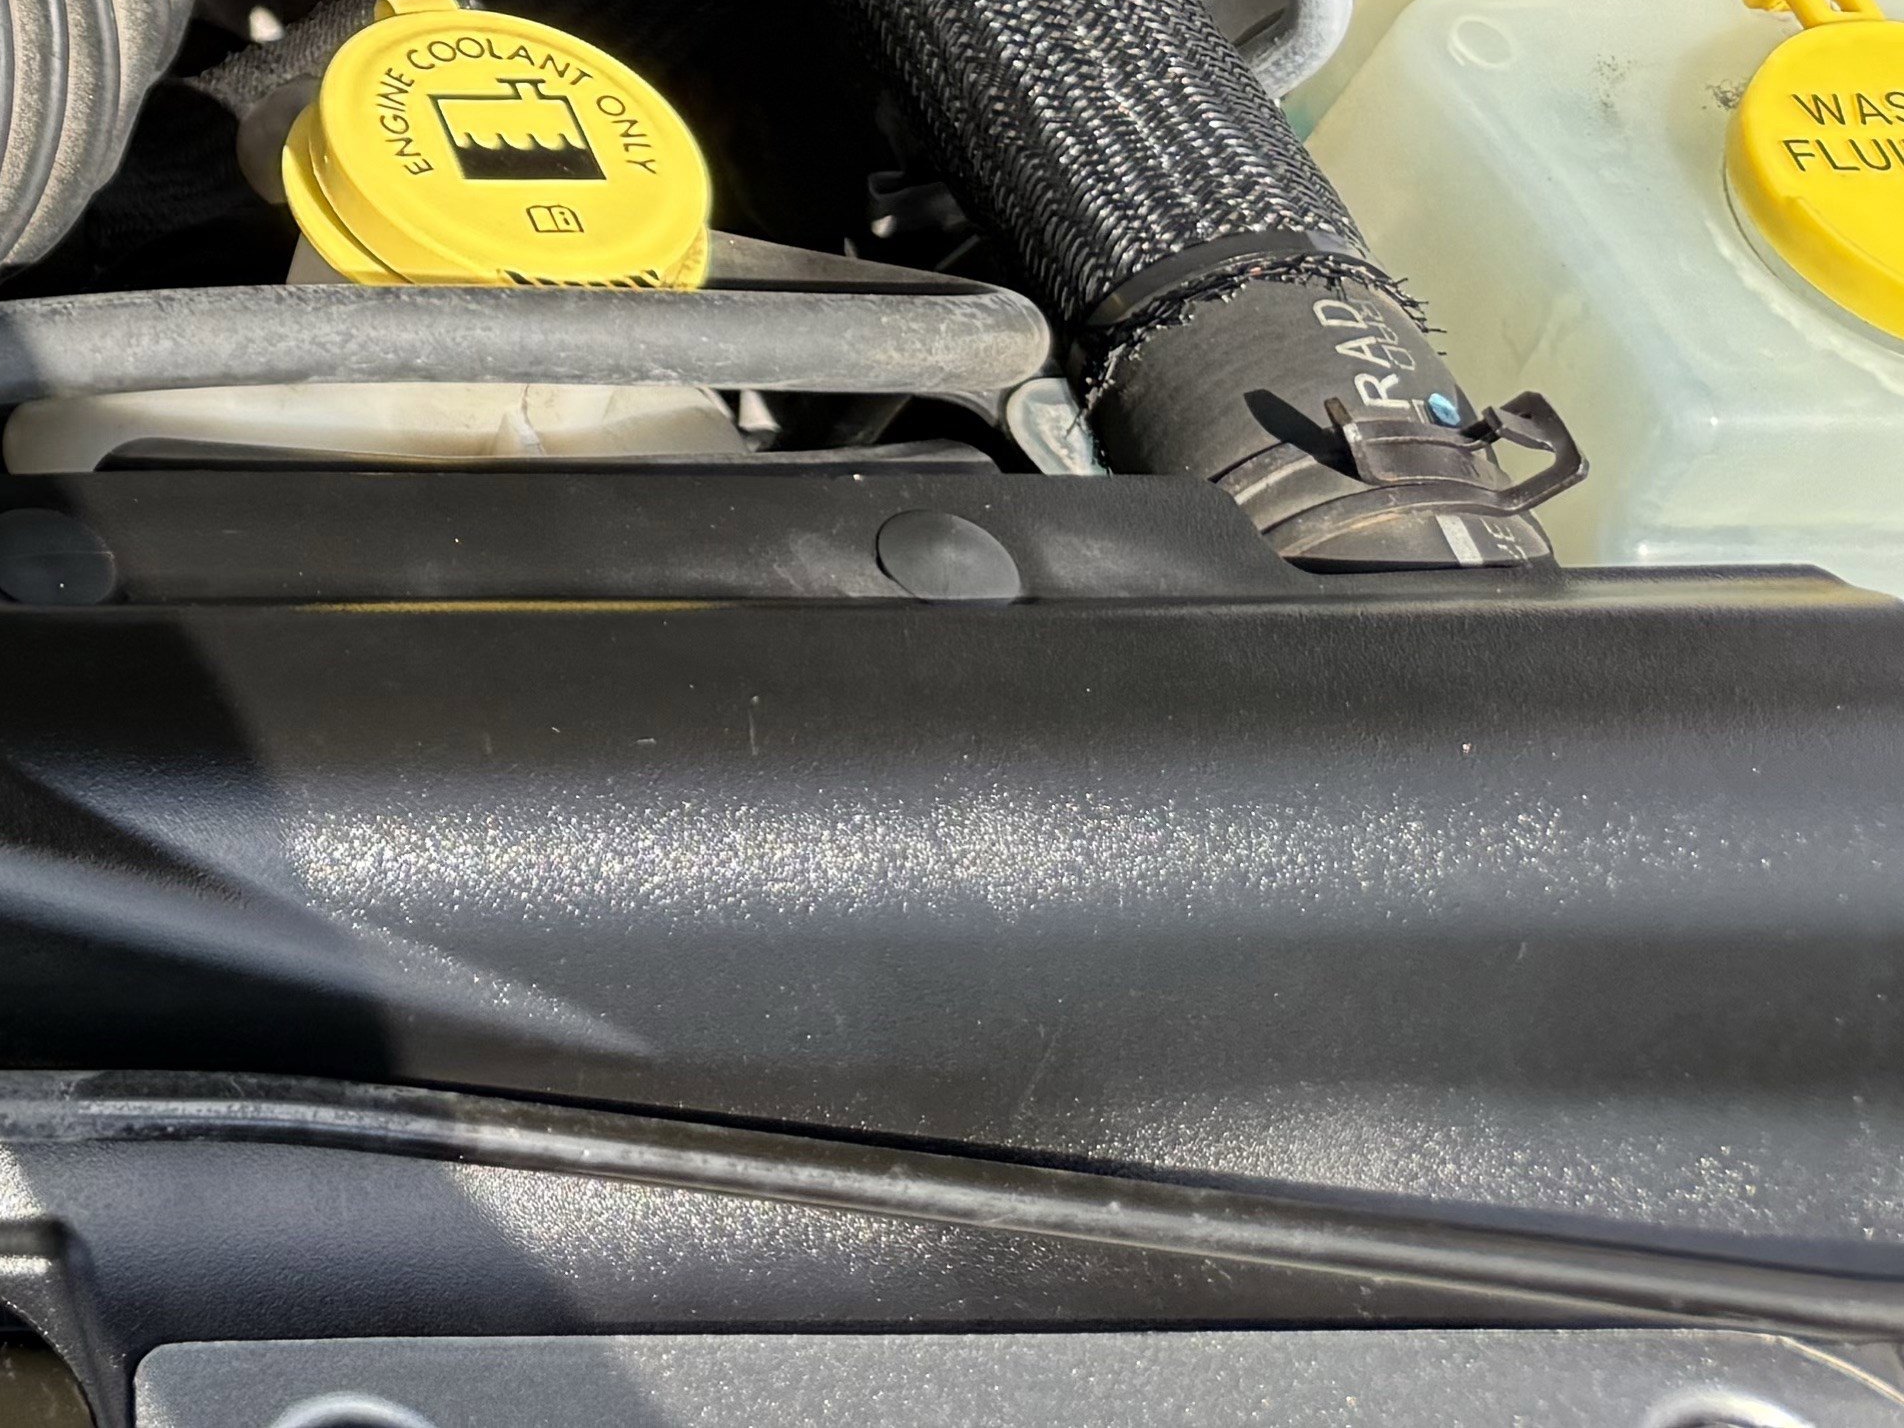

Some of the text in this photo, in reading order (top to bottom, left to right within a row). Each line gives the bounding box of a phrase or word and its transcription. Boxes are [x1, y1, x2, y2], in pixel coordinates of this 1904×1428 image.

[374, 36, 658, 177] ENGINE COOLANT ONLY
[1782, 138, 1904, 172] FLUI
[1312, 298, 1411, 410] RAD
